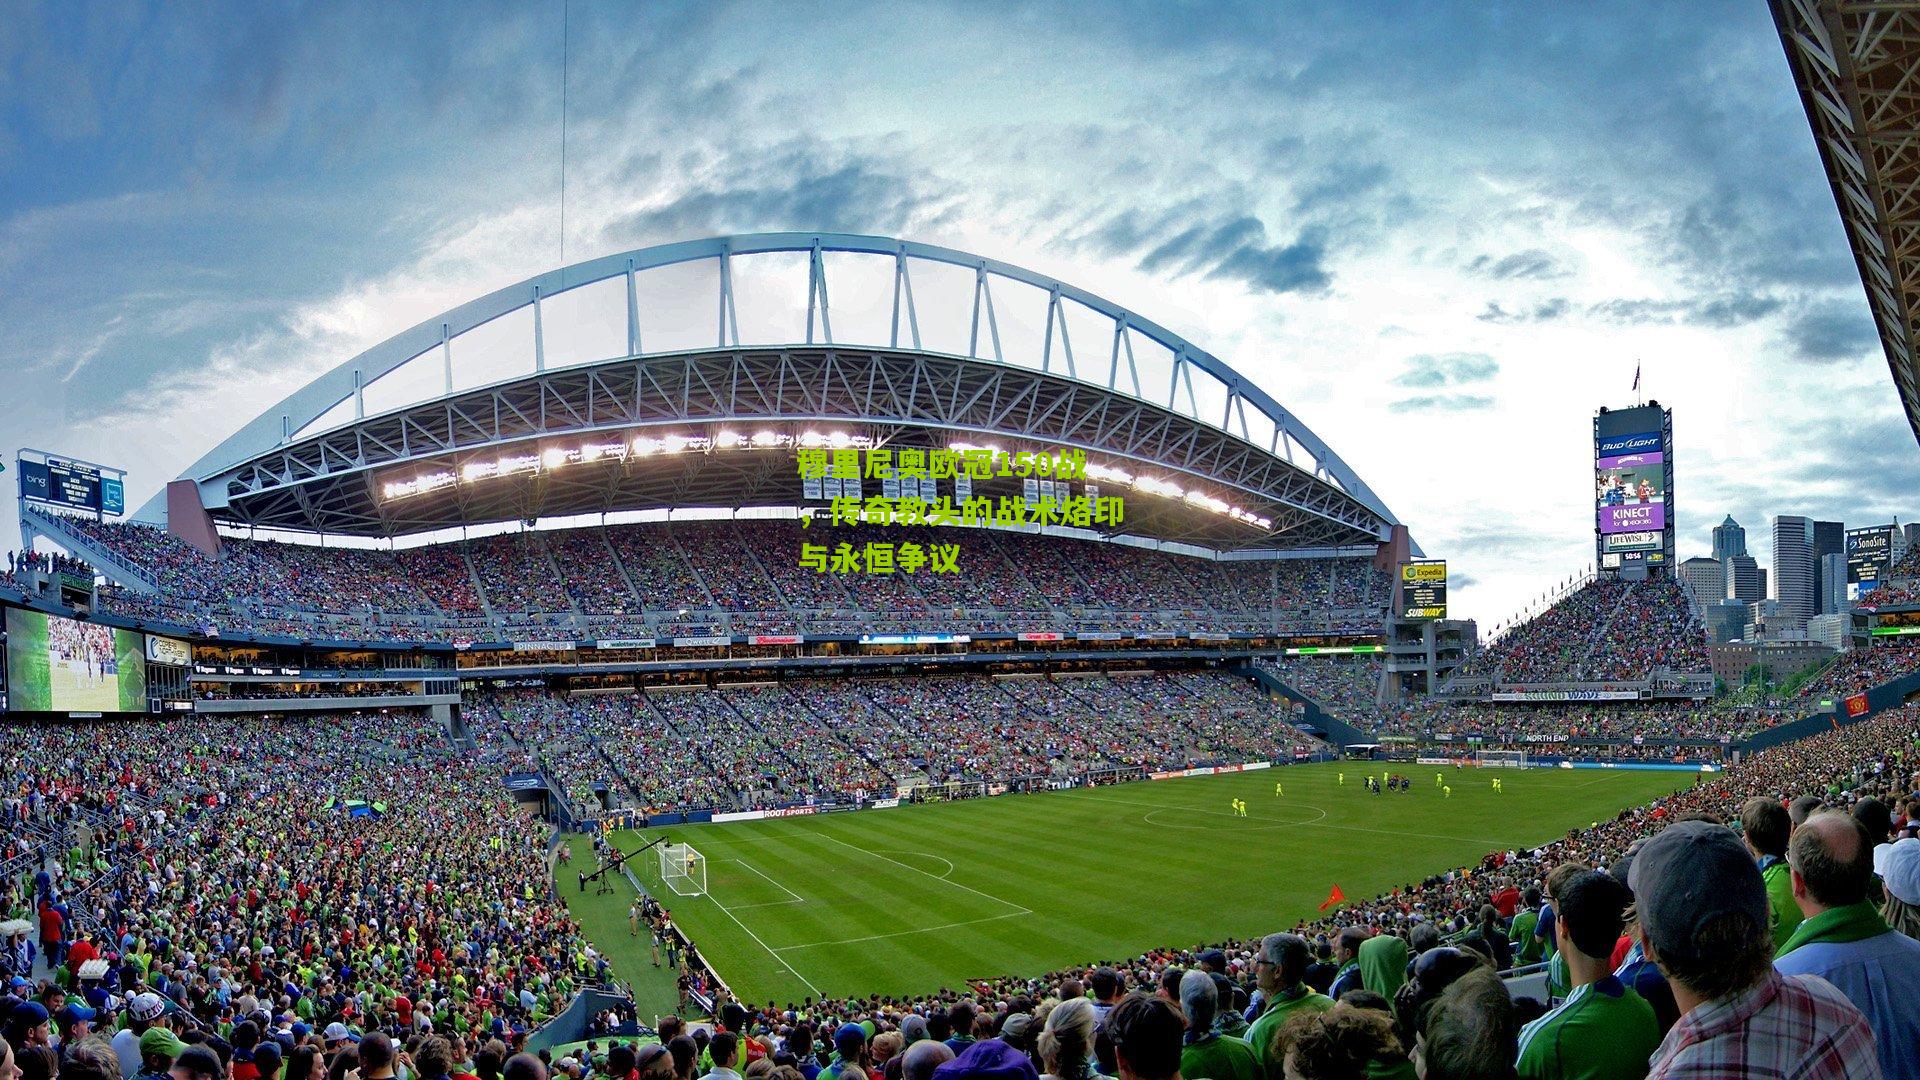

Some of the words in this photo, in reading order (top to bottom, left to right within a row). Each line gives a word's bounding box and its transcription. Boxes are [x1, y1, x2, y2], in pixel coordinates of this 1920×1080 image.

[1628, 438, 1658, 448] LIGHT
[26, 474, 46, 487] bing
[1613, 507, 1652, 519] KINECT
[1858, 536, 1886, 548] SonoSite
[1417, 569, 1442, 577] Expedia
[1405, 608, 1445, 617] SUBWAY
[685, 637, 709, 645] Qwest
[518, 642, 566, 650] PINNACLE
[1553, 734, 1569, 742] END
[764, 808, 786, 818] ROOT
